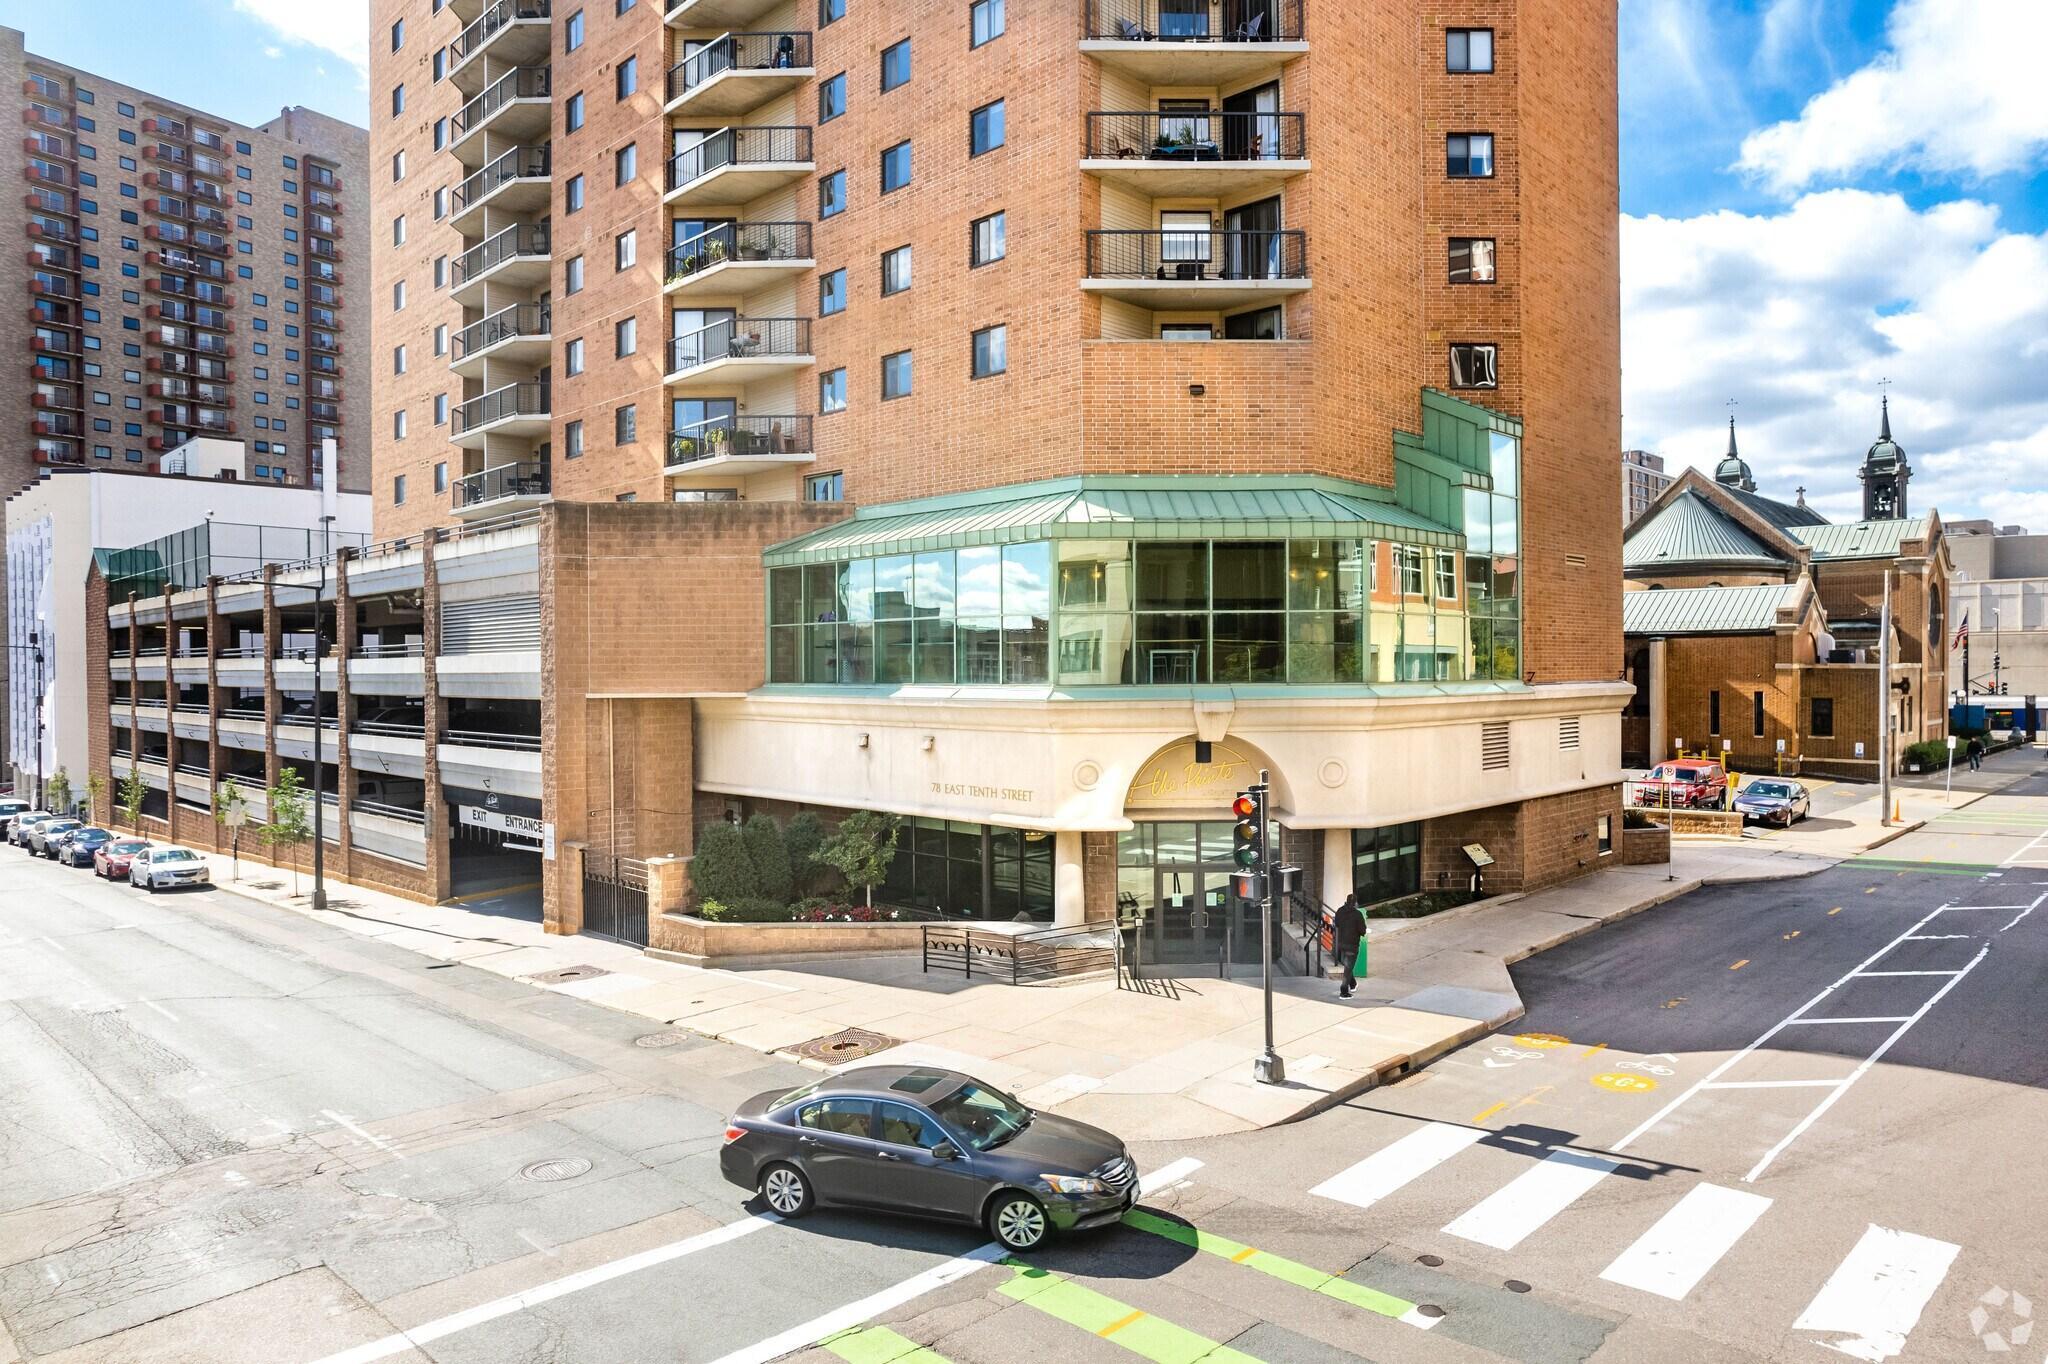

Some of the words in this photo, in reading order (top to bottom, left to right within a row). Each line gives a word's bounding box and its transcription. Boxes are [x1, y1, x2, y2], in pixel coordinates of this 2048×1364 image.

[931, 782, 941, 793] 78
[944, 783, 965, 796] EAST
[968, 785, 998, 799] TENTH
[1001, 788, 1033, 802] STREET
[473, 810, 487, 822] EXIT
[505, 816, 543, 833] ENTRANCE
